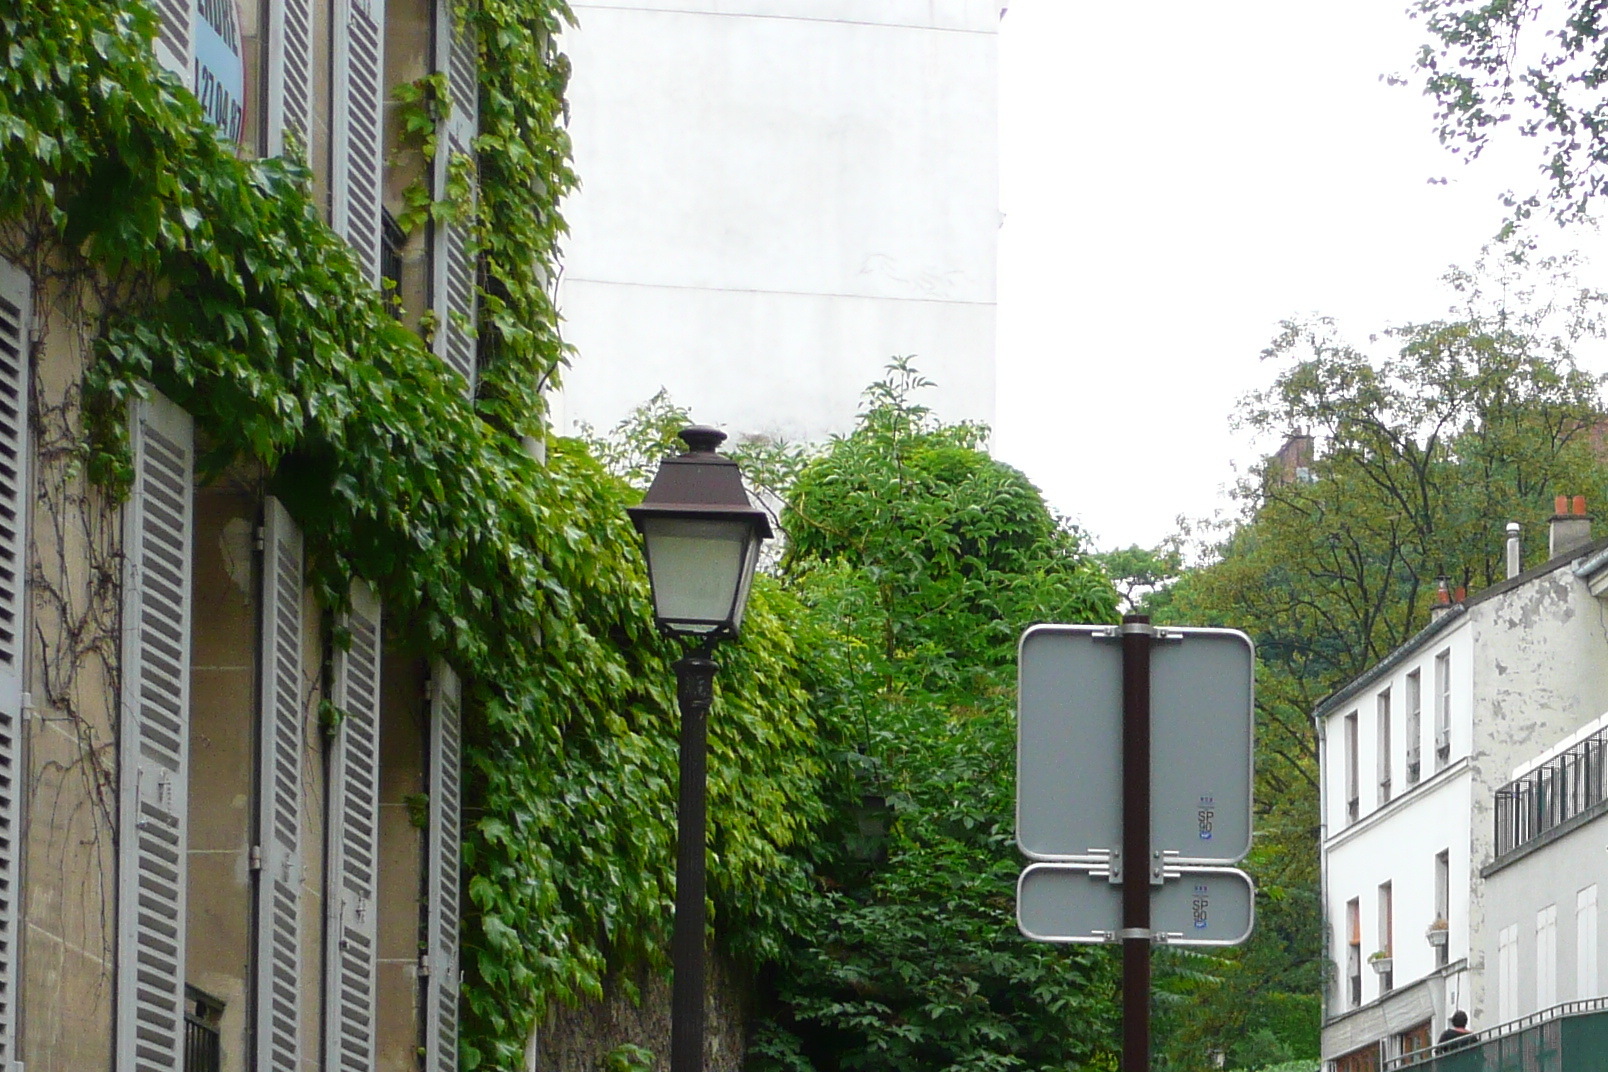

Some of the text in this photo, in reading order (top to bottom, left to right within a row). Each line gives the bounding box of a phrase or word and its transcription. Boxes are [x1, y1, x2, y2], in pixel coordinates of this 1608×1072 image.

[202, 64, 214, 117] 27
[215, 80, 229, 135] 04
[230, 98, 242, 143] 87
[1198, 811, 1214, 822] SP
[1192, 900, 1209, 911] SP
